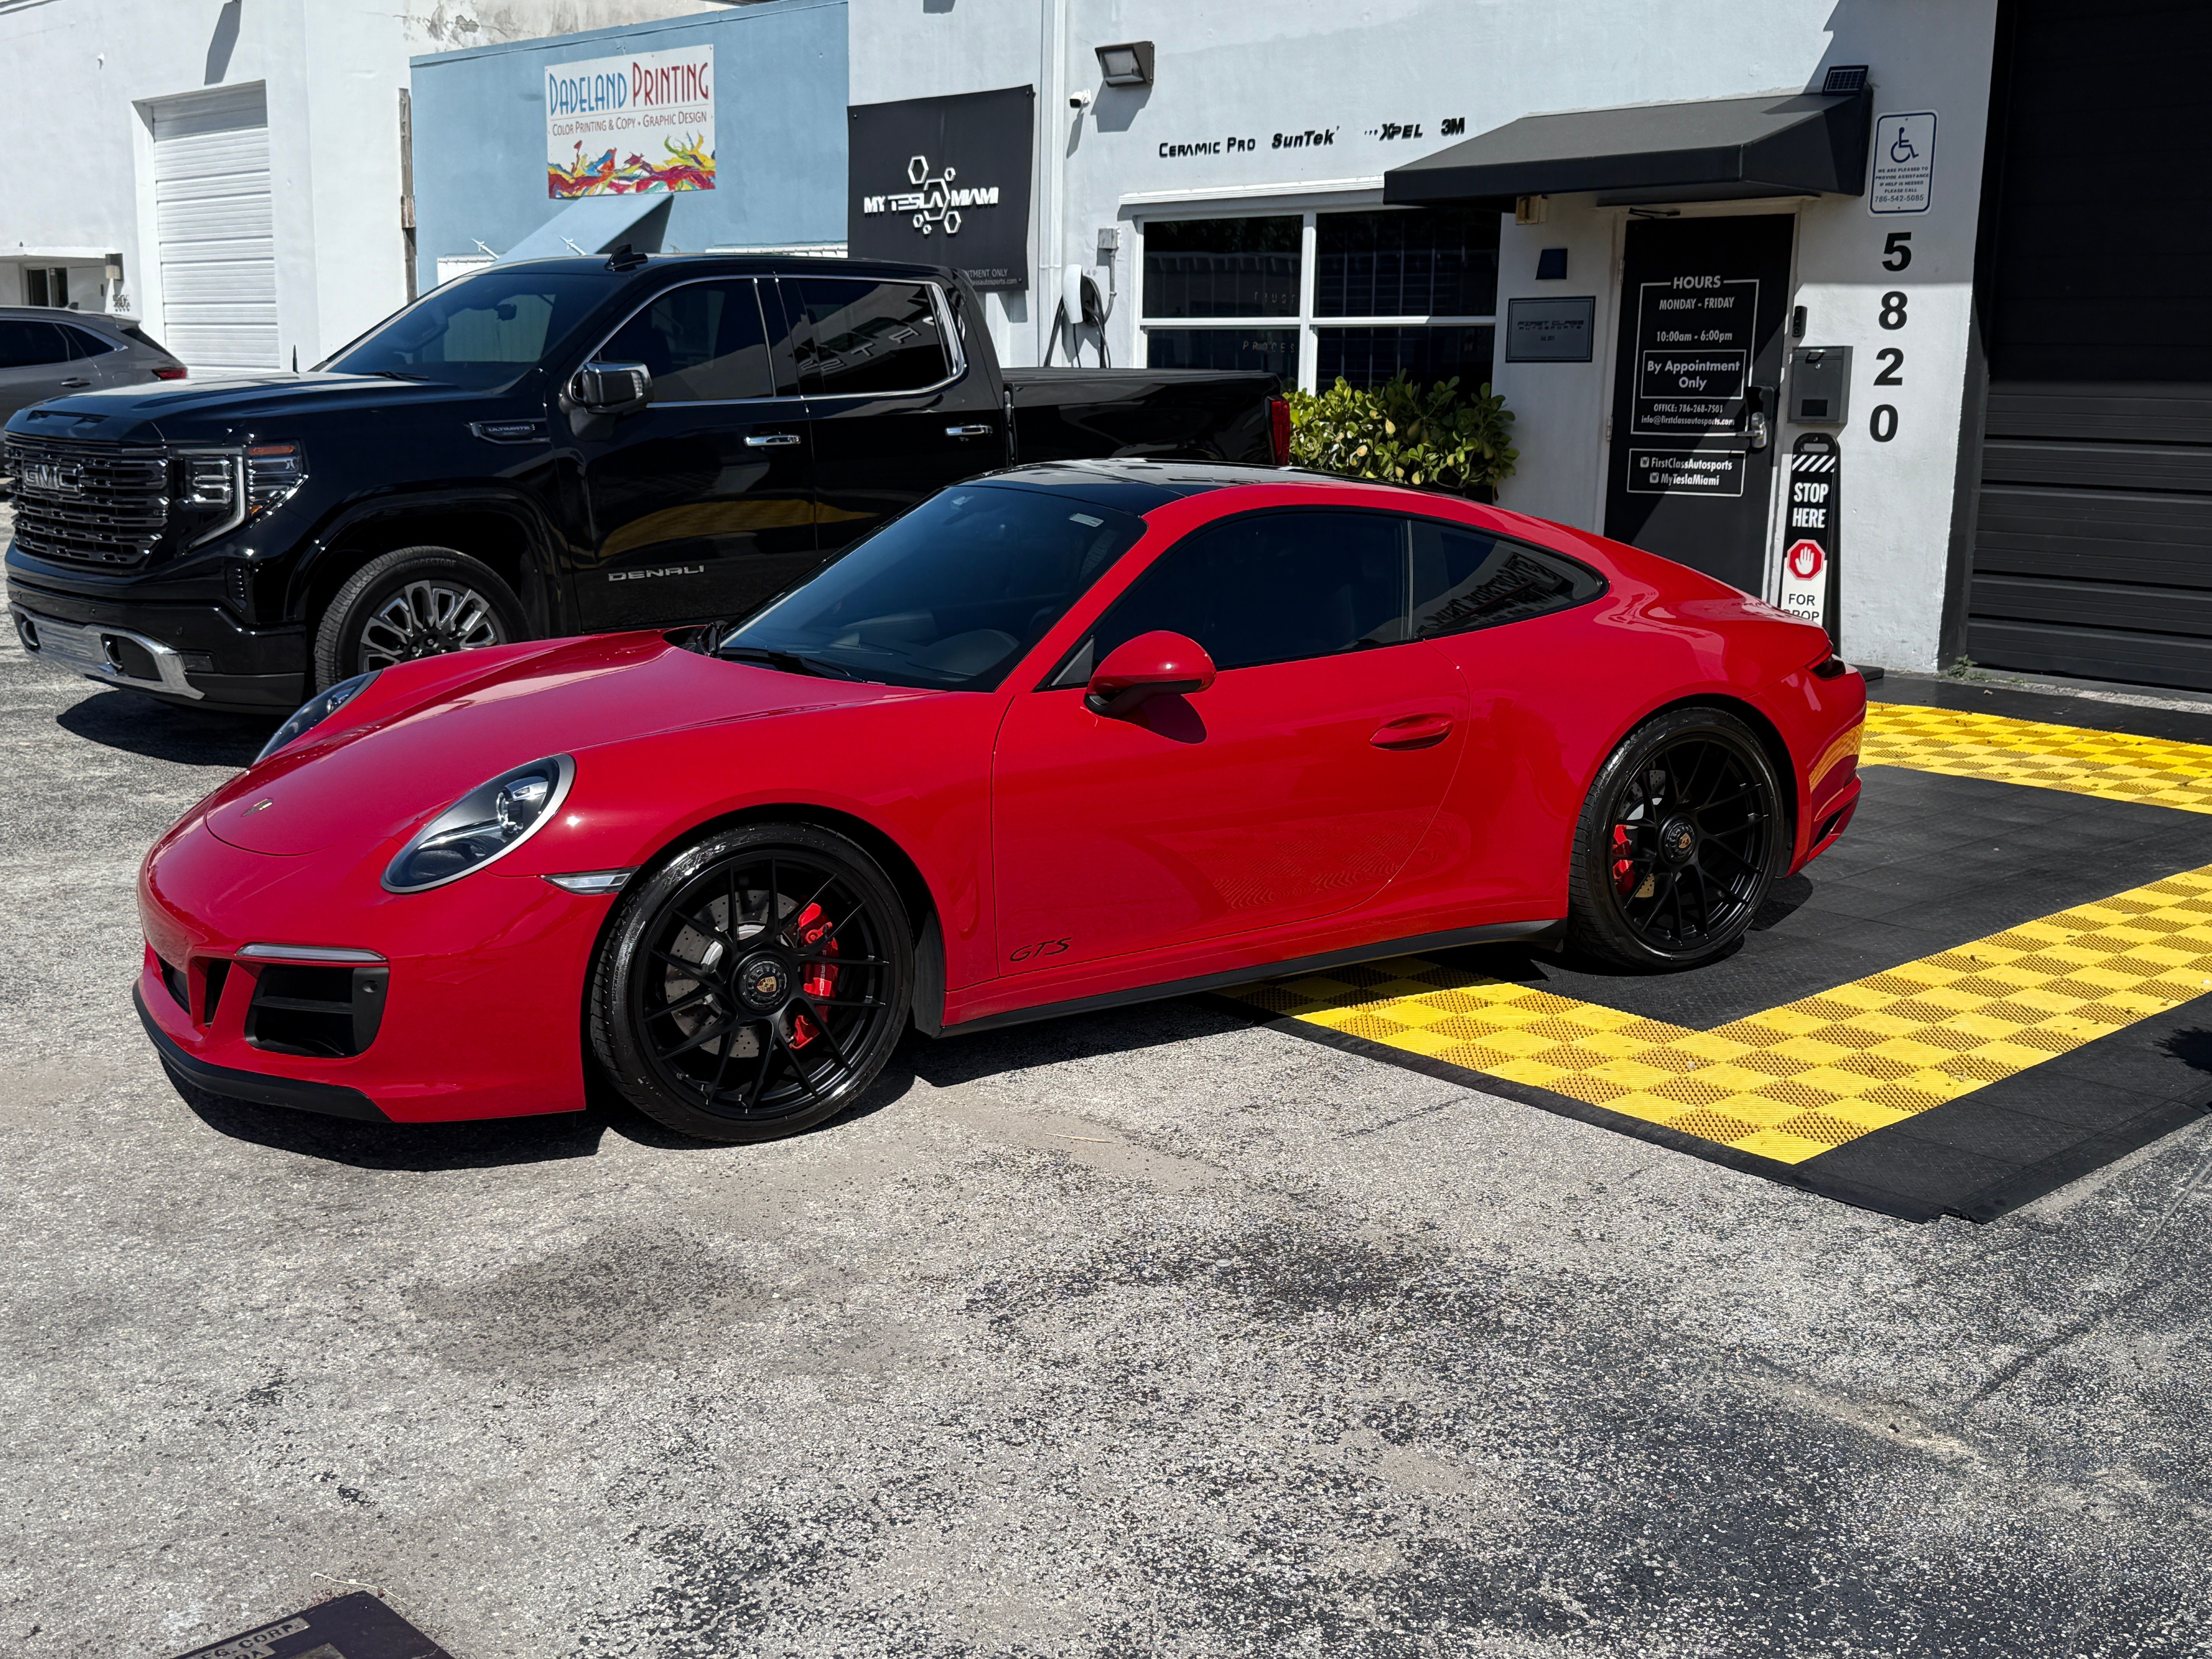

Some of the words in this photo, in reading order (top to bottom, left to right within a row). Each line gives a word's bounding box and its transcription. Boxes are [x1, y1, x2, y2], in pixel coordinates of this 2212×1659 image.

[549, 72, 627, 116] DADELAND
[633, 62, 709, 107] PRINTING
[553, 123, 574, 136] COLOR
[575, 120, 606, 133] PRINTING
[609, 122, 614, 130] &
[616, 117, 636, 130] COPY
[643, 114, 677, 127] GRAPHIC
[679, 111, 707, 124] DESIGN
[1441, 117, 1465, 136] 3M
[1272, 129, 1335, 149] SunTek
[863, 196, 886, 213] MY
[888, 191, 944, 211] TESLA
[951, 187, 999, 207] MIAMI
[991, 268, 1008, 278] ONLY
[1673, 275, 1721, 289] HOURS
[1659, 298, 1696, 310] MONDAY
[1704, 297, 1735, 309] FRIDAY
[1657, 330, 1692, 342] 10:00am
[1700, 330, 1733, 343] 6:00pm
[1647, 361, 1662, 374] By
[1665, 359, 1740, 374] Appointment
[1679, 376, 1707, 391] Only
[1654, 404, 1677, 412] OFFICE:
[1651, 457, 1733, 472] FirstClassAutosports
[25, 464, 79, 493] GMC
[1661, 473, 1720, 486] MyTeslaMiami
[1793, 482, 1829, 503] STOP
[1792, 507, 1827, 529] HERE
[608, 565, 704, 581] DENALI
[1788, 593, 1815, 606] FOR
[1783, 609, 1819, 621] OP
[1010, 937, 1072, 962] GTS
